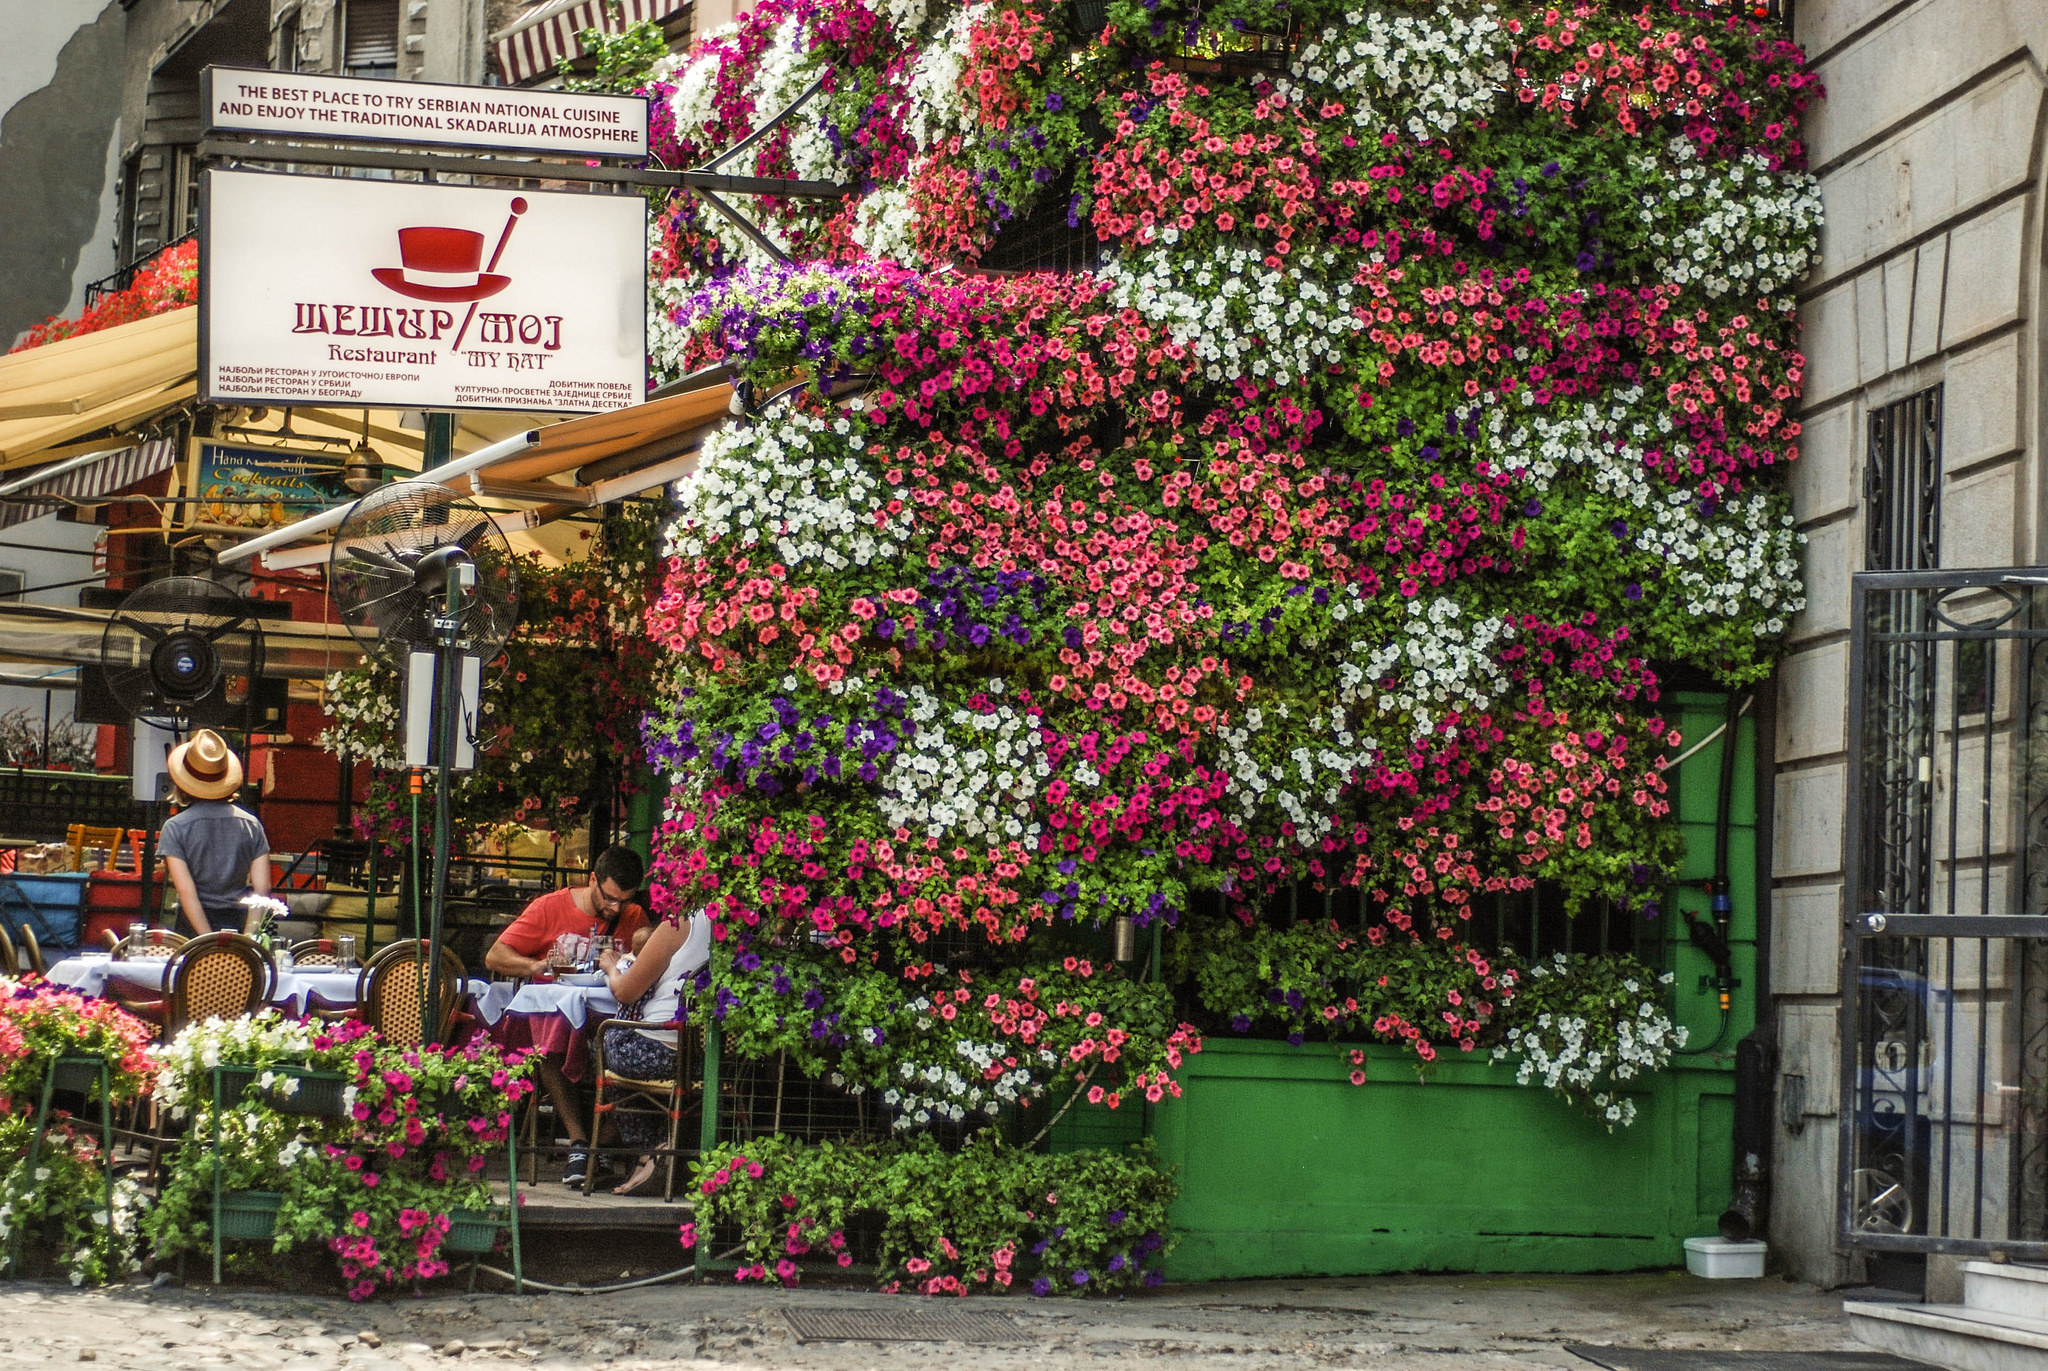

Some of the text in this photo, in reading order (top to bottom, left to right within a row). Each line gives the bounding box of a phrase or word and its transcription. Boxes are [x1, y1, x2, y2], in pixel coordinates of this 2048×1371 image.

[238, 85, 620, 123] THE BEST PLACE TO TRY SERBIAN NATIONAL CUISINE
[219, 102, 639, 142] AND ENJOY THE TRADITIONAL SKADARLIJA ATMOSPHERE
[328, 344, 437, 365] Restaurant
[219, 366, 262, 374] НАЈБОЉИ
[265, 368, 309, 377] РЕСТОРАН
[386, 373, 420, 382] ЕВРОПИ
[219, 375, 262, 384] НАЈБОЉИ
[265, 377, 309, 386] РЕСТОРАН
[318, 380, 351, 388] СРБИЈИ
[219, 385, 262, 393] НАЈБОЉИ
[265, 387, 309, 395] РЕСТОРАН
[318, 389, 363, 398] БЕОГРАДУ
[549, 380, 595, 389] ДОБИТНИК
[456, 394, 503, 404] ДОБИТНИК
[602, 391, 632, 400] СРБИЈЕ
[212, 446, 243, 466] Hand
[213, 467, 305, 489] Cocktails
